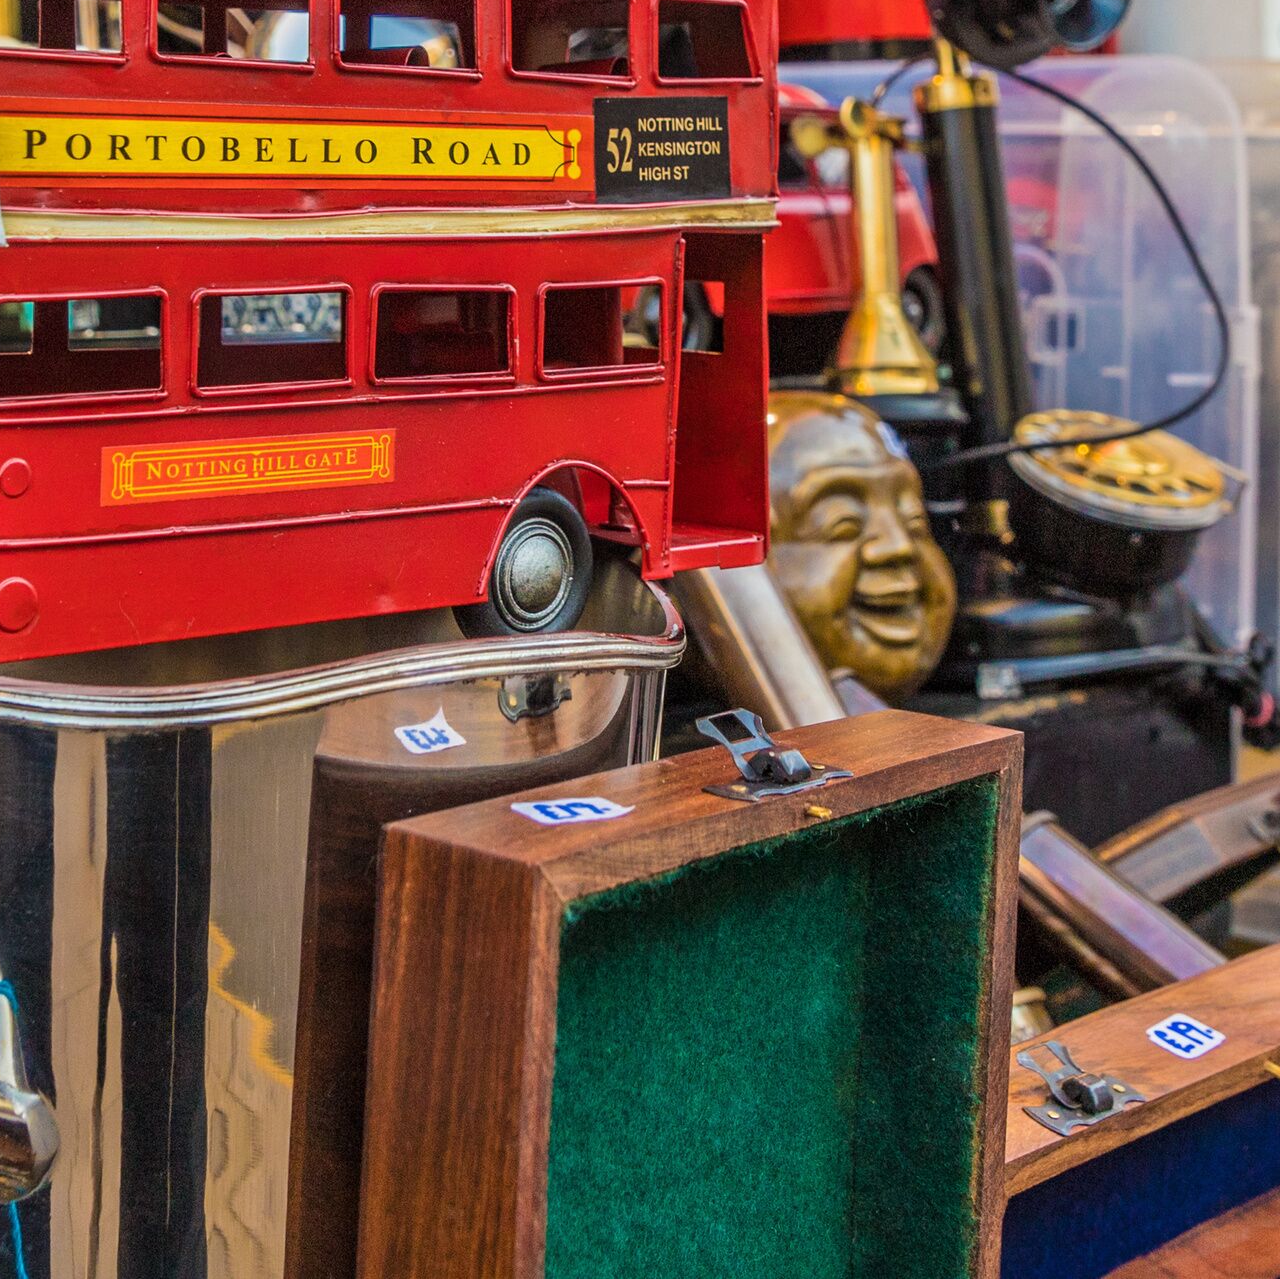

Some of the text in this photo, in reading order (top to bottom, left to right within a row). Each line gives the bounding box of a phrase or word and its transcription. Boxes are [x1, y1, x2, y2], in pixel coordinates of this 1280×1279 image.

[637, 116, 723, 132] NOTTING HILL
[22, 128, 532, 167] PORTOBELLO ROAD
[606, 128, 634, 174] 52
[637, 140, 721, 157] KENSINGTON
[638, 165, 690, 182] HIGH ST
[145, 447, 358, 481] NOTTING HILL GATE
